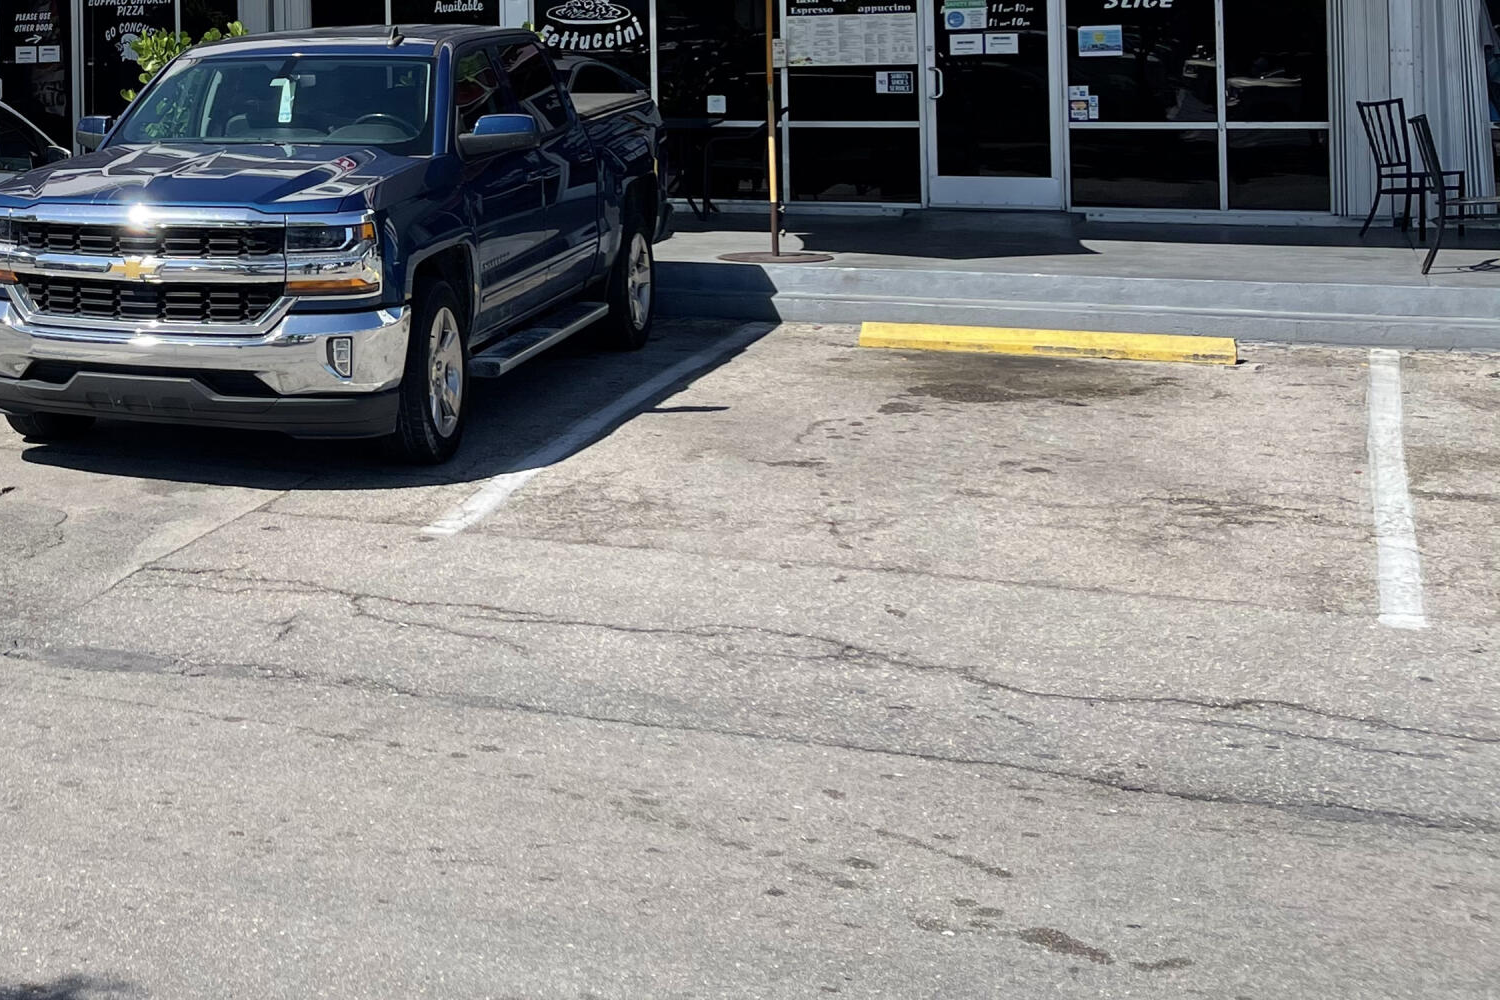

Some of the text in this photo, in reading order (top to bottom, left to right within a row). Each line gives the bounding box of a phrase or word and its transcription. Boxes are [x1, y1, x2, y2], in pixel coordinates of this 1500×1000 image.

[116, 5, 144, 16] PIZZA
[434, 0, 484, 13] Available
[790, 3, 911, 15] Espresso appuccino
[15, 11, 51, 22] PLEASE USE
[14, 23, 53, 33] OTHER DOOR
[105, 26, 116, 41] GO
[541, 16, 644, 50] Fettuccini
